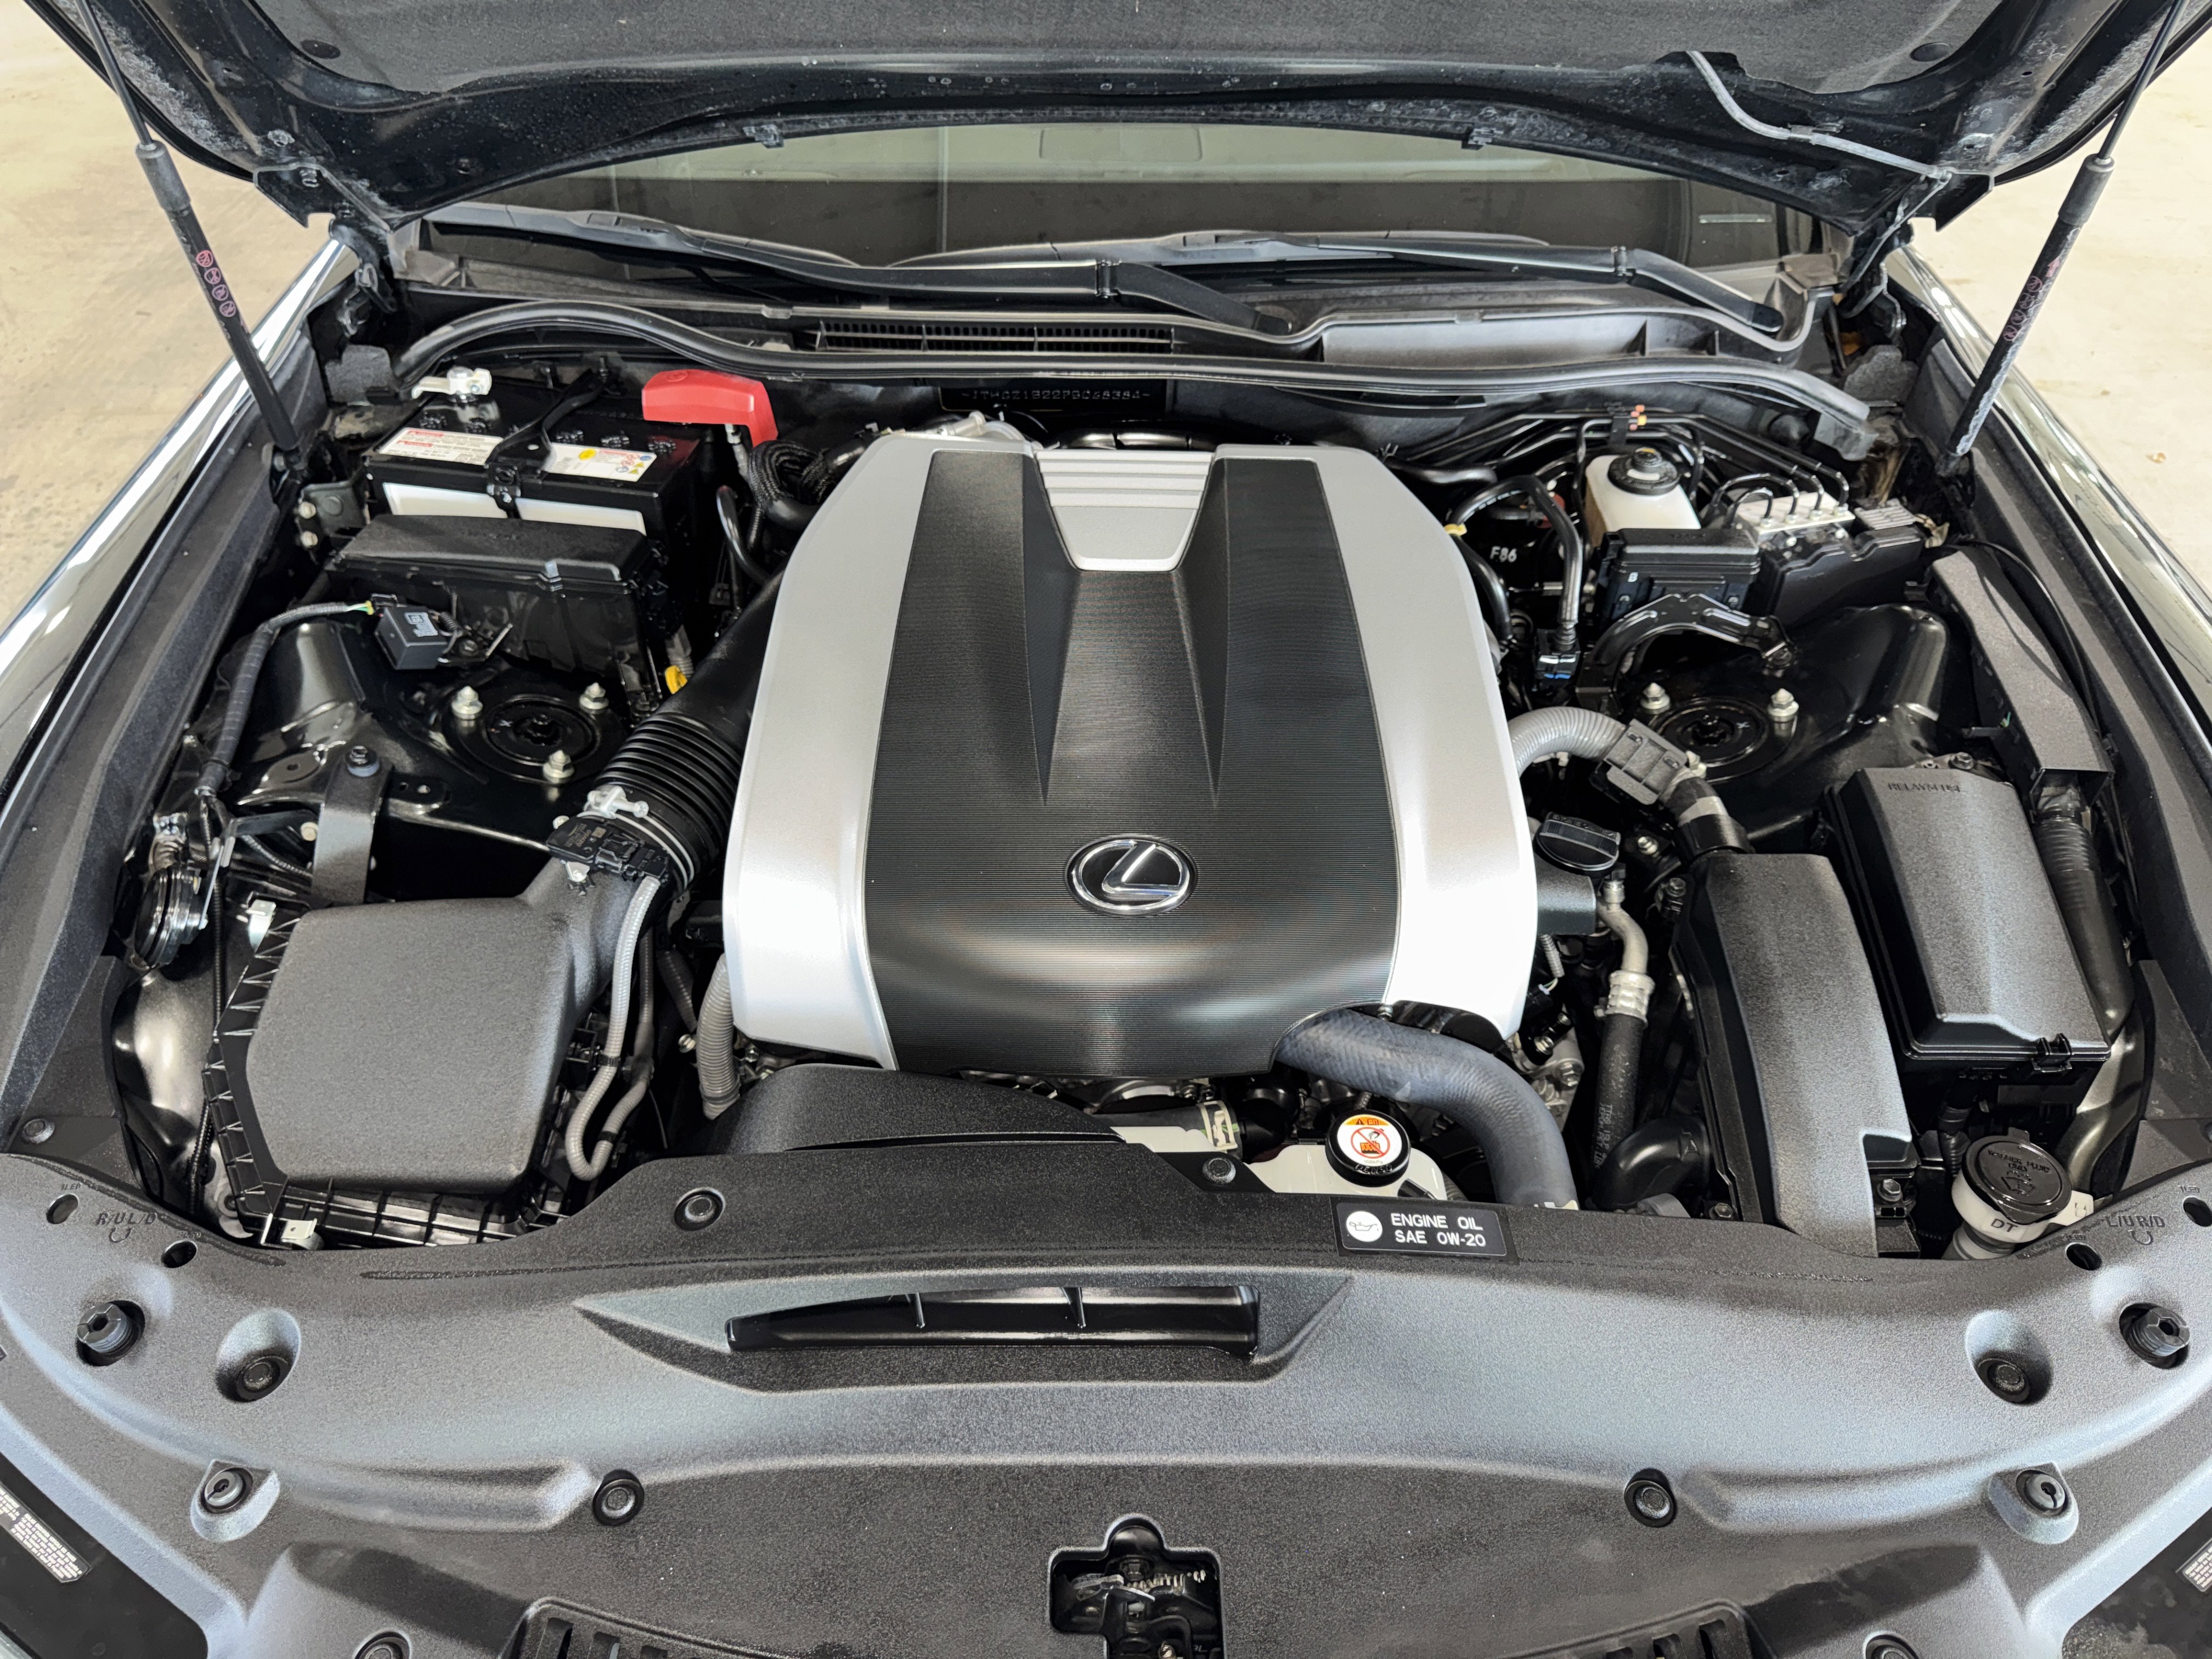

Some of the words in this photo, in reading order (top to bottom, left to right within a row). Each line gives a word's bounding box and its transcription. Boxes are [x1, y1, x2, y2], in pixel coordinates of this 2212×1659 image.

[1489, 545, 1517, 563] F86
[1390, 1212, 1448, 1229] ENGINE
[1457, 1216, 1484, 1231] OIL
[1990, 1218, 2019, 1233] DT
[1394, 1229, 1428, 1245] SAE
[1436, 1231, 1486, 1247] 0W-20
